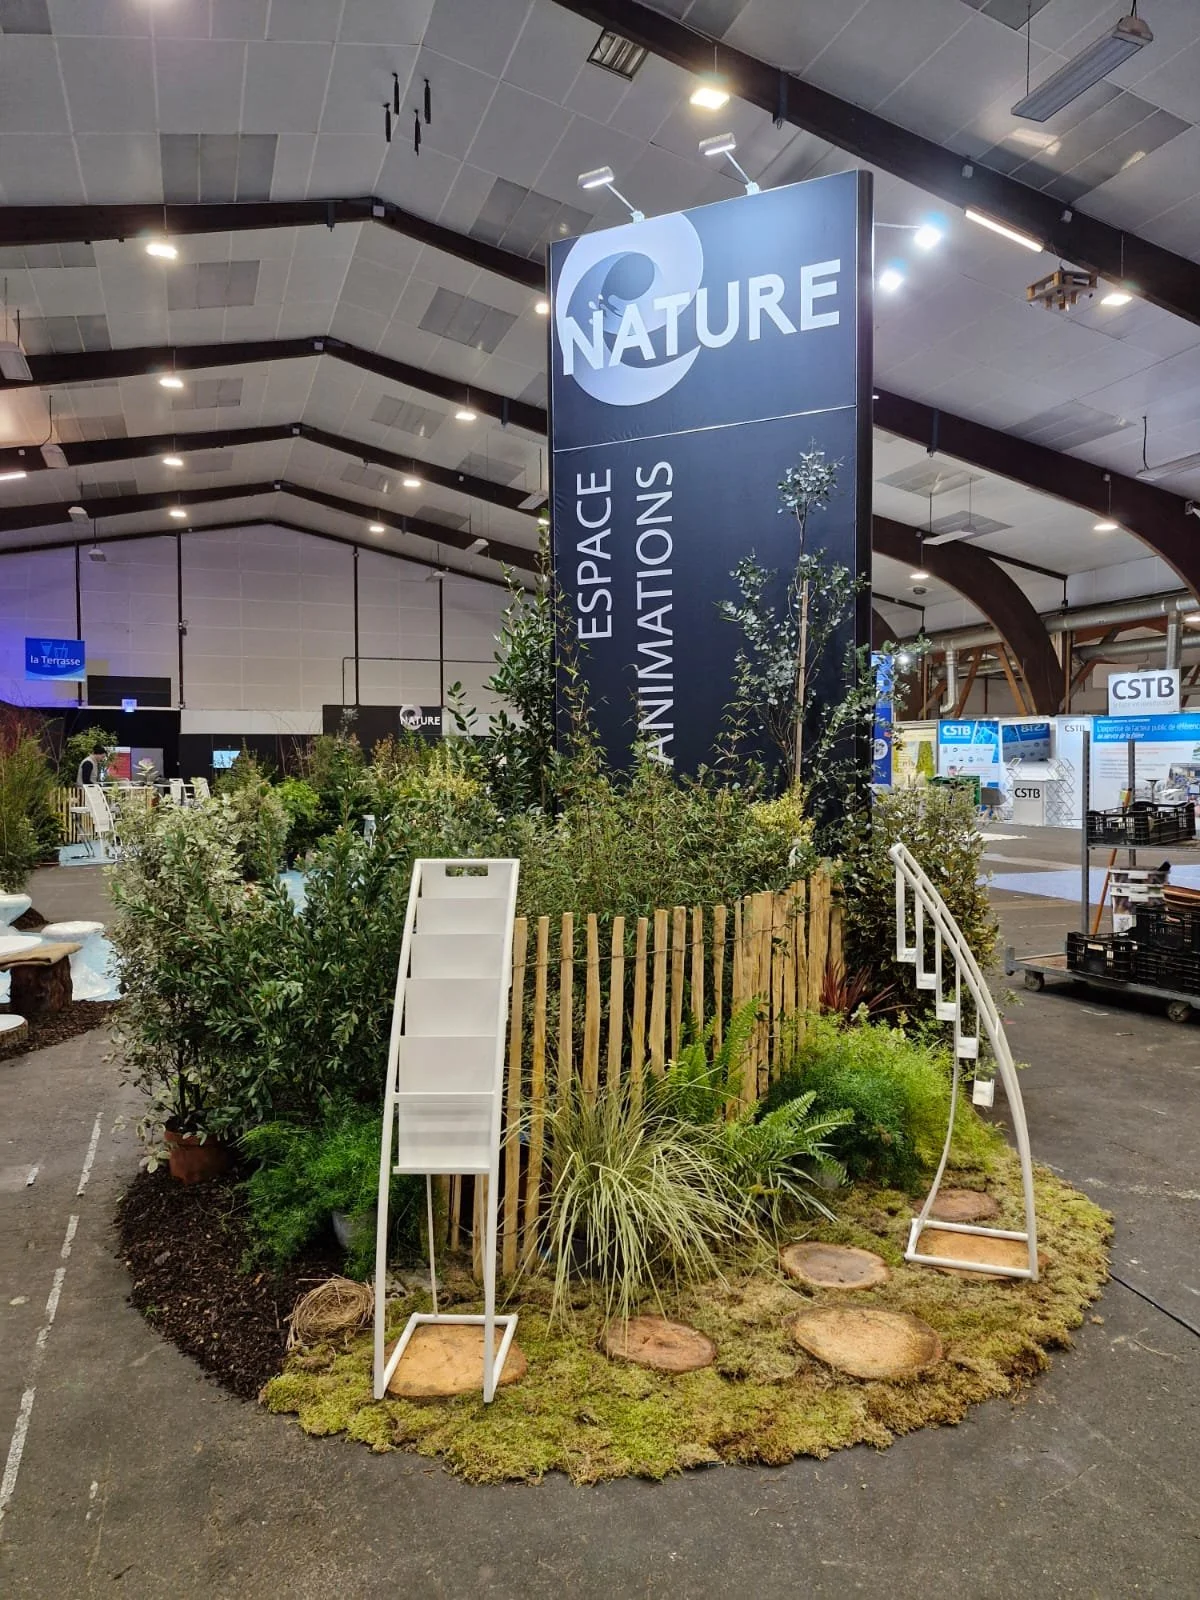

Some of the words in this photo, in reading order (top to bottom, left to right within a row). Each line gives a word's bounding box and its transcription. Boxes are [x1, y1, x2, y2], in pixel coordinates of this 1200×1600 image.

[563, 259, 841, 376] NATURE
[576, 468, 613, 639] ESPACE
[635, 461, 674, 766] ANIMATIONS
[30, 655, 39, 664] la
[41, 655, 81, 666] Terrasse
[1112, 676, 1175, 700] CSTB
[400, 716, 441, 726] NATURE
[942, 725, 971, 736] CSTB
[1014, 787, 1041, 798] CSTB
